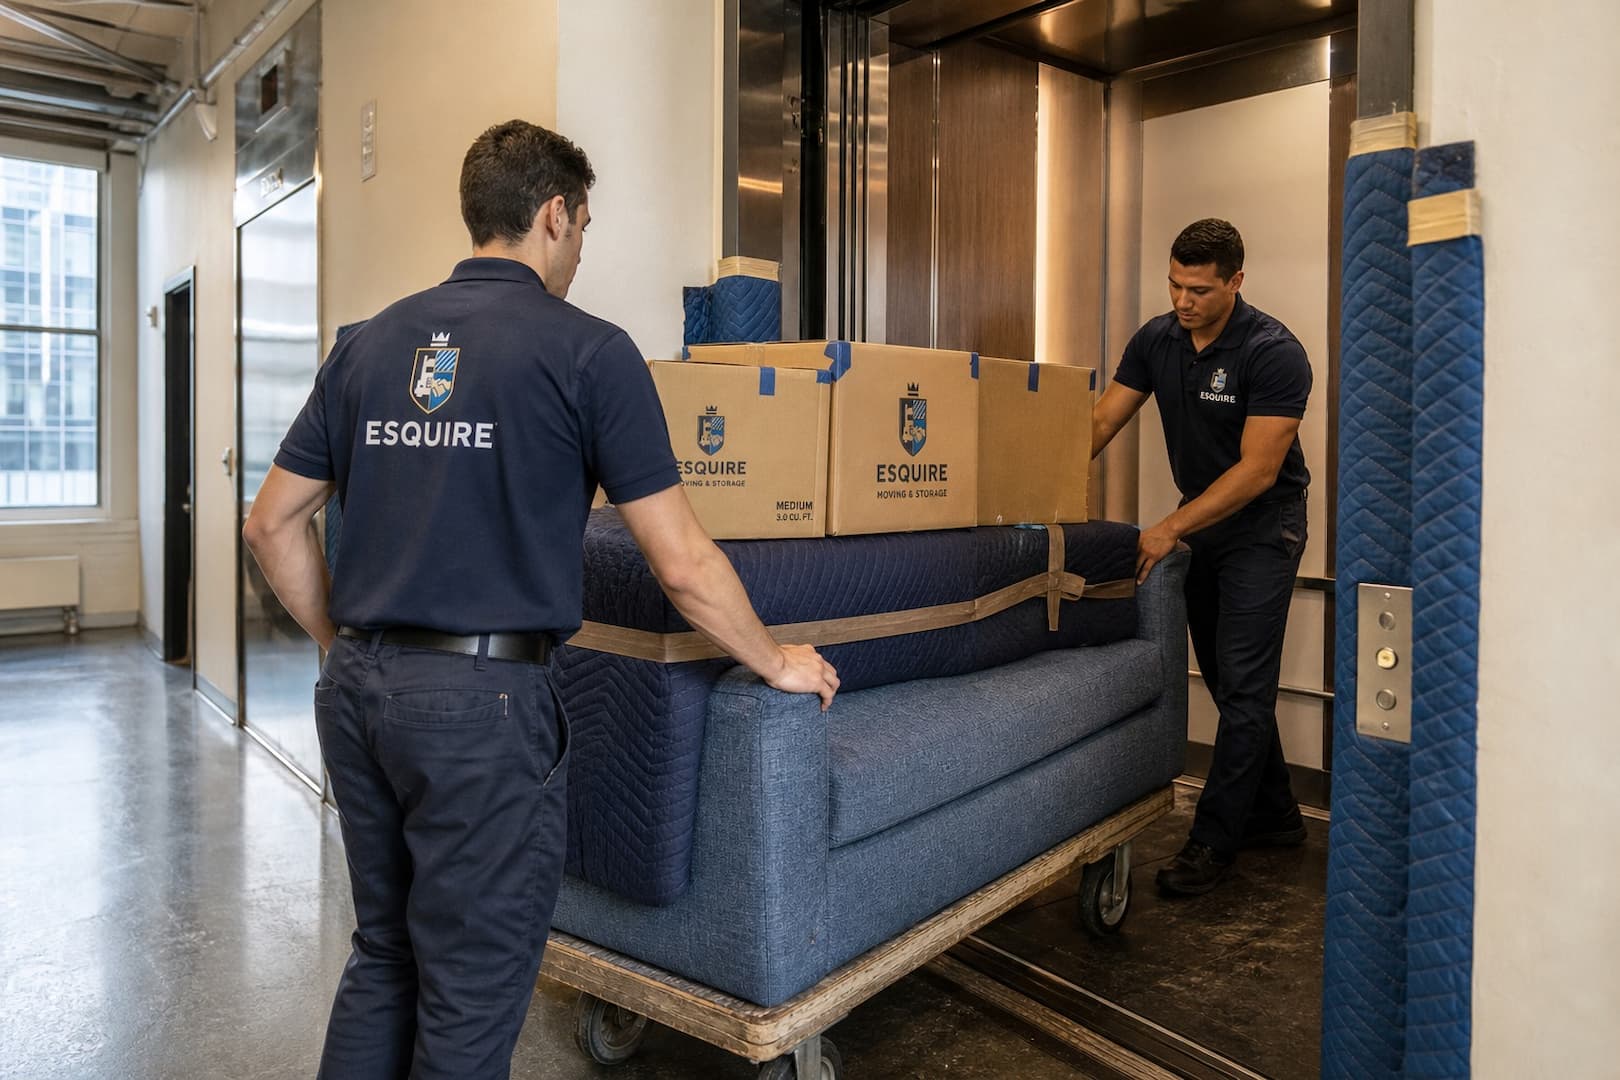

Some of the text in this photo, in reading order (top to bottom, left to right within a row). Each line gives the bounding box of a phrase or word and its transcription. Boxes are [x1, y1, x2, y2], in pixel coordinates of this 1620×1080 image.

[1200, 391, 1236, 403] ESQUIRE
[365, 420, 494, 449] ESQUIRE
[876, 463, 948, 483] ESQUIRE
[876, 490, 907, 499] MOVING
[915, 488, 948, 498] STORAGE
[776, 501, 813, 510] MEDIUM
